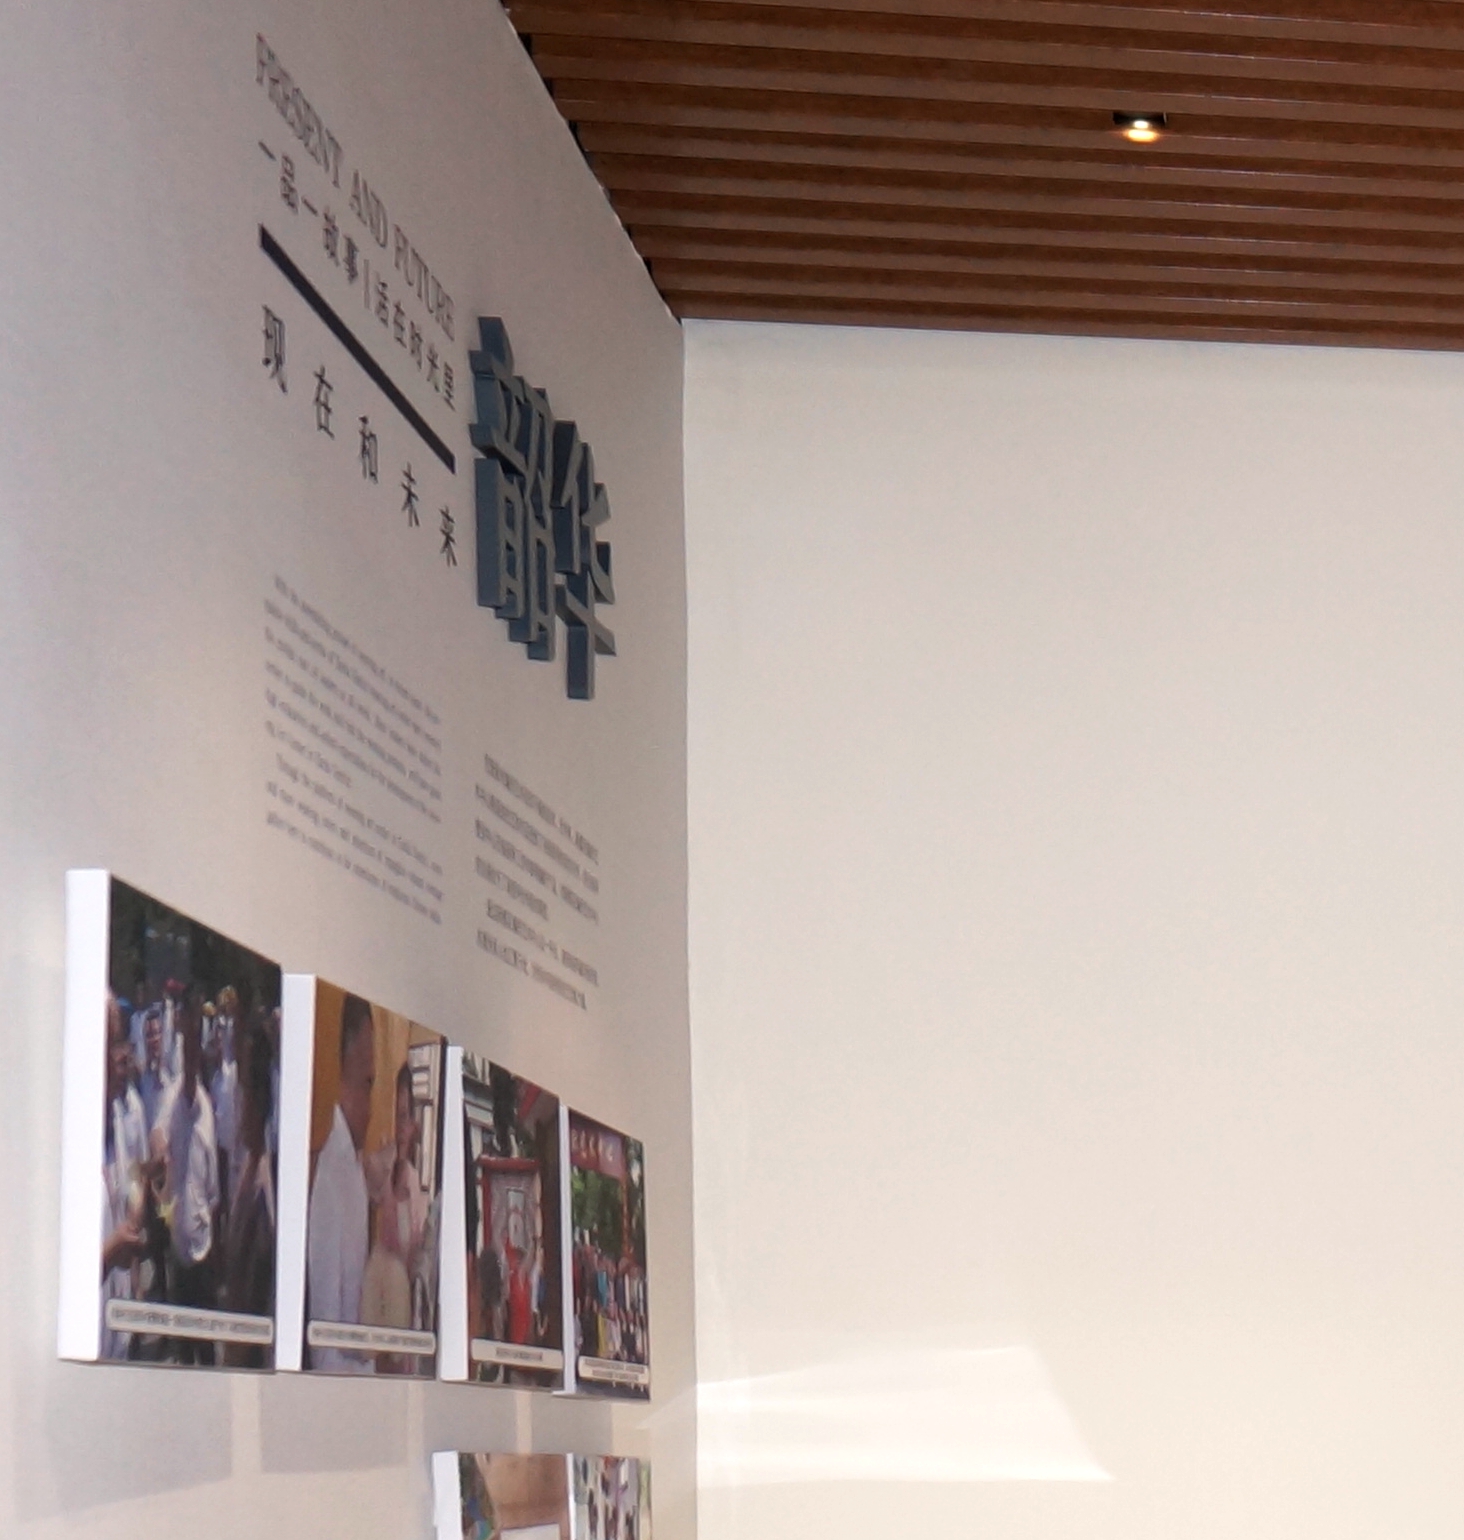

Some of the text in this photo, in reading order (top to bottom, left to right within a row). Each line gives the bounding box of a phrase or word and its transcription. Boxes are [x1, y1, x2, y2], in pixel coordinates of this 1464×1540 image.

[256, 32, 456, 342] PRESENT AND FUTURE
[262, 304, 458, 568] 现在和未来
